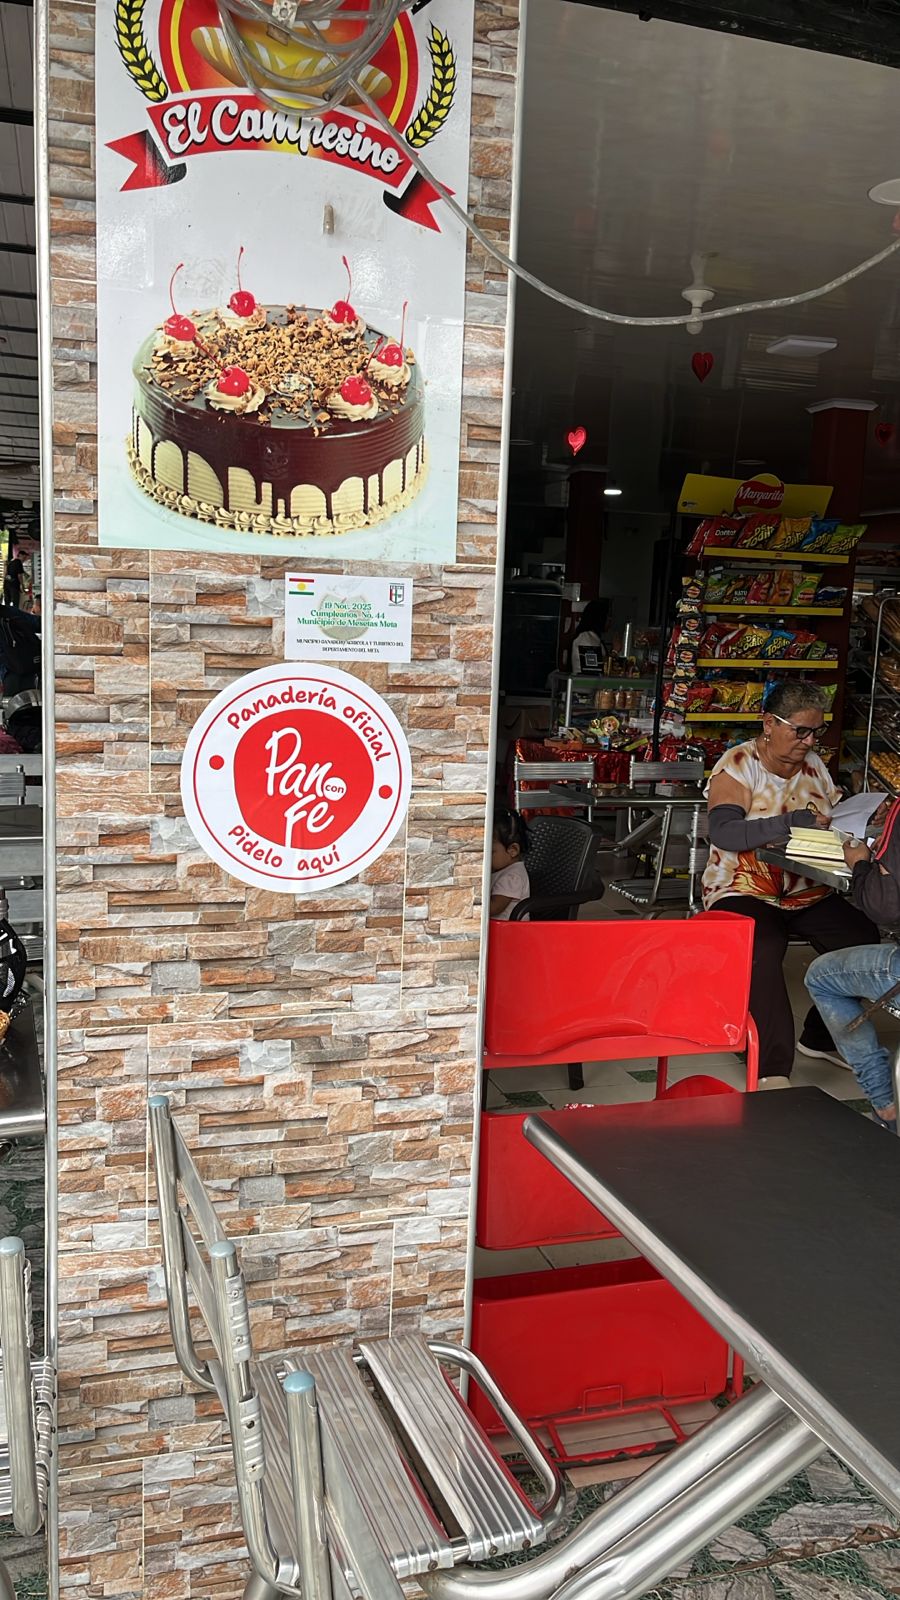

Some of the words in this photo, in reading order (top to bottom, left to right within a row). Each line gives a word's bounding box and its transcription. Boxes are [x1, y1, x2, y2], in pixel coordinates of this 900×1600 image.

[163, 101, 209, 154] El
[211, 99, 404, 174] Campesino
[737, 486, 784, 504] Margarita
[297, 617, 335, 627] Municipio
[348, 619, 378, 627] Mesetas
[379, 620, 398, 628] Meta
[352, 603, 372, 611] 2025
[227, 686, 337, 729] Panadería
[342, 706, 391, 762] oficial
[264, 727, 333, 797] Pan
[325, 784, 344, 794] con
[284, 794, 334, 848] Fe
[228, 824, 283, 868] Pidelo
[297, 844, 341, 873] aquí
